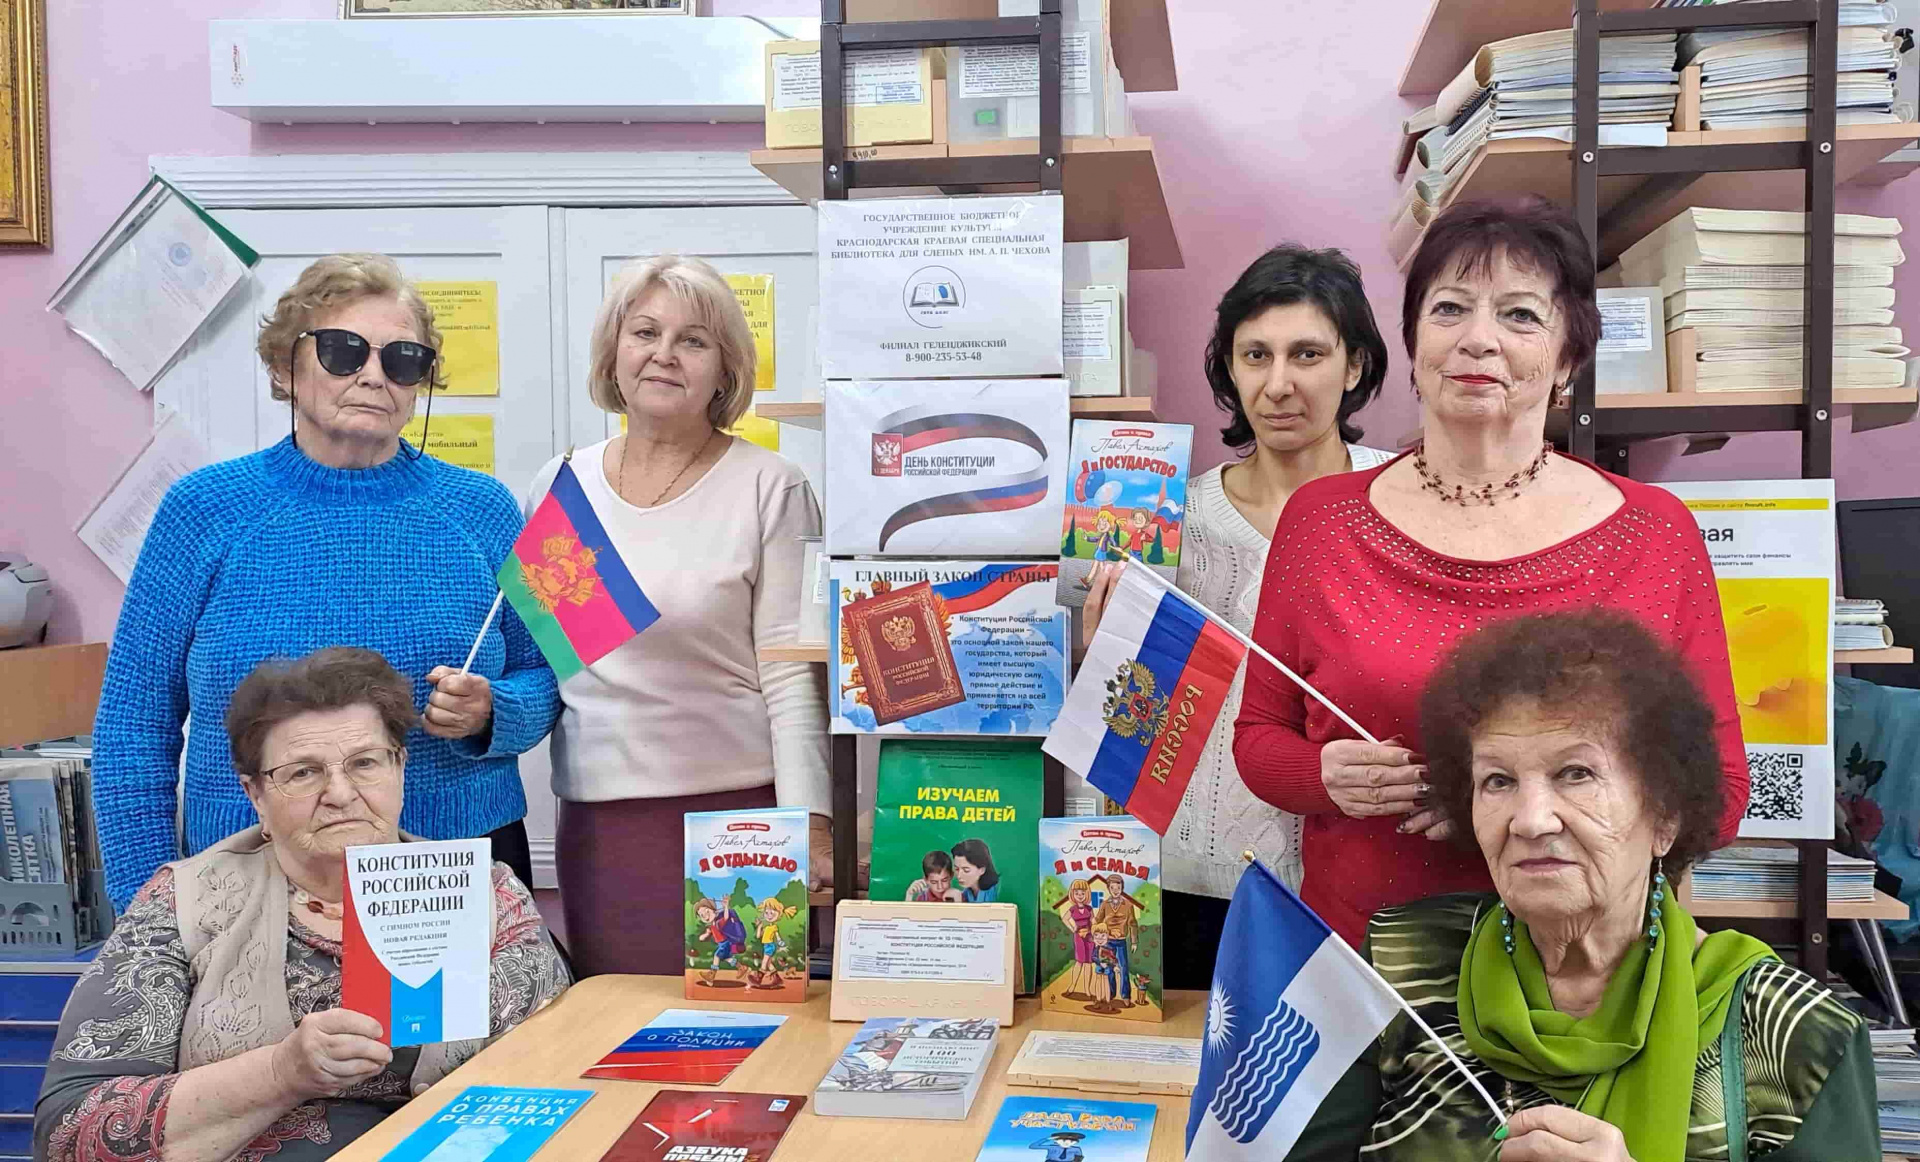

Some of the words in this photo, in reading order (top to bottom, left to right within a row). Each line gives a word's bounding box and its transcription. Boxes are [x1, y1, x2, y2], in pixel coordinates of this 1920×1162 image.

[863, 213, 956, 222] ГОСУДАРСТВЕННОЕ
[882, 225, 947, 234] УЧРЕЖДЕНИЕ
[950, 224, 1002, 232] КУЛЬТУ
[836, 237, 919, 247] КРАСНОДАРСКАЯ
[923, 236, 967, 245] КРАЕВАЯ
[971, 234, 1045, 244] СПЕЦИАЛЬНАЯ
[831, 250, 895, 259] БИБЛИОТЕКА
[899, 250, 919, 258] ДЛЯ
[923, 249, 964, 257] СЛЕПЫХ
[1011, 246, 1051, 255] ЧЕХОВА
[880, 341, 919, 350] ФИЛИАЛ
[923, 338, 1007, 349] ГЕЛЕНДЖИКСКИЙ
[905, 351, 982, 362] 8-900-235-53-48
[1091, 437, 1126, 453] Павел
[1125, 438, 1174, 454] Астахов
[904, 456, 929, 468] ДЕНЬ
[930, 455, 995, 468] КОНСТИТУЦИИ
[1081, 459, 1090, 474] Я
[1099, 454, 1178, 478] ГОСУДАРСТВО
[903, 467, 941, 476] РОССИЙСКОЙ
[941, 468, 978, 476] ФЕДЕРАЦИИ
[855, 568, 929, 582] ГЛАВНЫЙ
[932, 570, 983, 583] ЗАКОН
[987, 570, 1051, 583] СТРАНЫ
[959, 615, 1007, 624] Конституция
[1008, 614, 1053, 623] Российской
[980, 626, 1025, 634] Федерации
[964, 638, 1000, 646] основной
[965, 650, 1012, 658] государства,
[1014, 649, 1047, 658] который
[883, 656, 935, 676] КОНСТИТУЦИЯ
[1003, 661, 1035, 669] высшую
[969, 671, 1022, 679] юридическую
[1024, 671, 1044, 680] силу,
[970, 682, 999, 690] прямое
[1001, 681, 1036, 690] действие
[967, 692, 1016, 700] применяется
[1029, 692, 1046, 700] всей
[977, 702, 1021, 711] территории
[1022, 702, 1035, 711] РФ.
[917, 786, 1000, 803] ИЗУЧАЕМ
[899, 805, 959, 820] ПРАВА
[961, 805, 1016, 823] ДЕТЕЙ
[707, 834, 743, 850] Павел
[742, 834, 791, 850] Астахов
[1061, 839, 1098, 855] Павел
[1097, 840, 1145, 858] Астахов
[357, 851, 475, 874] КОНСТИТУЦИЯ
[699, 858, 711, 873] Я
[712, 852, 798, 873] ОТДЫХАЮ
[1054, 859, 1067, 876] Я
[1086, 856, 1150, 881] СЕМЬЯ
[361, 870, 470, 896] РОССИЙСКОЙ
[367, 895, 464, 918] ФЕДЕРАЦИИ
[386, 922, 420, 931] ГИМНОМ
[421, 919, 451, 928] РОССИИ
[383, 935, 408, 944] НОВАЯ
[409, 932, 448, 942] РЕДАКЦИЯ
[672, 1029, 733, 1039] ЗАКОН
[664, 1035, 746, 1047] ПОЛИЦИИ
[462, 1094, 579, 1106] КОНВЕНЦИЯ
[451, 1103, 465, 1113] О
[474, 1104, 571, 1116] ПРАВАХ
[436, 1114, 556, 1127] РЕБЕНКА
[668, 1145, 749, 1156] АЗБУКА
[662, 1153, 745, 1162] ПОБЕДЫ
